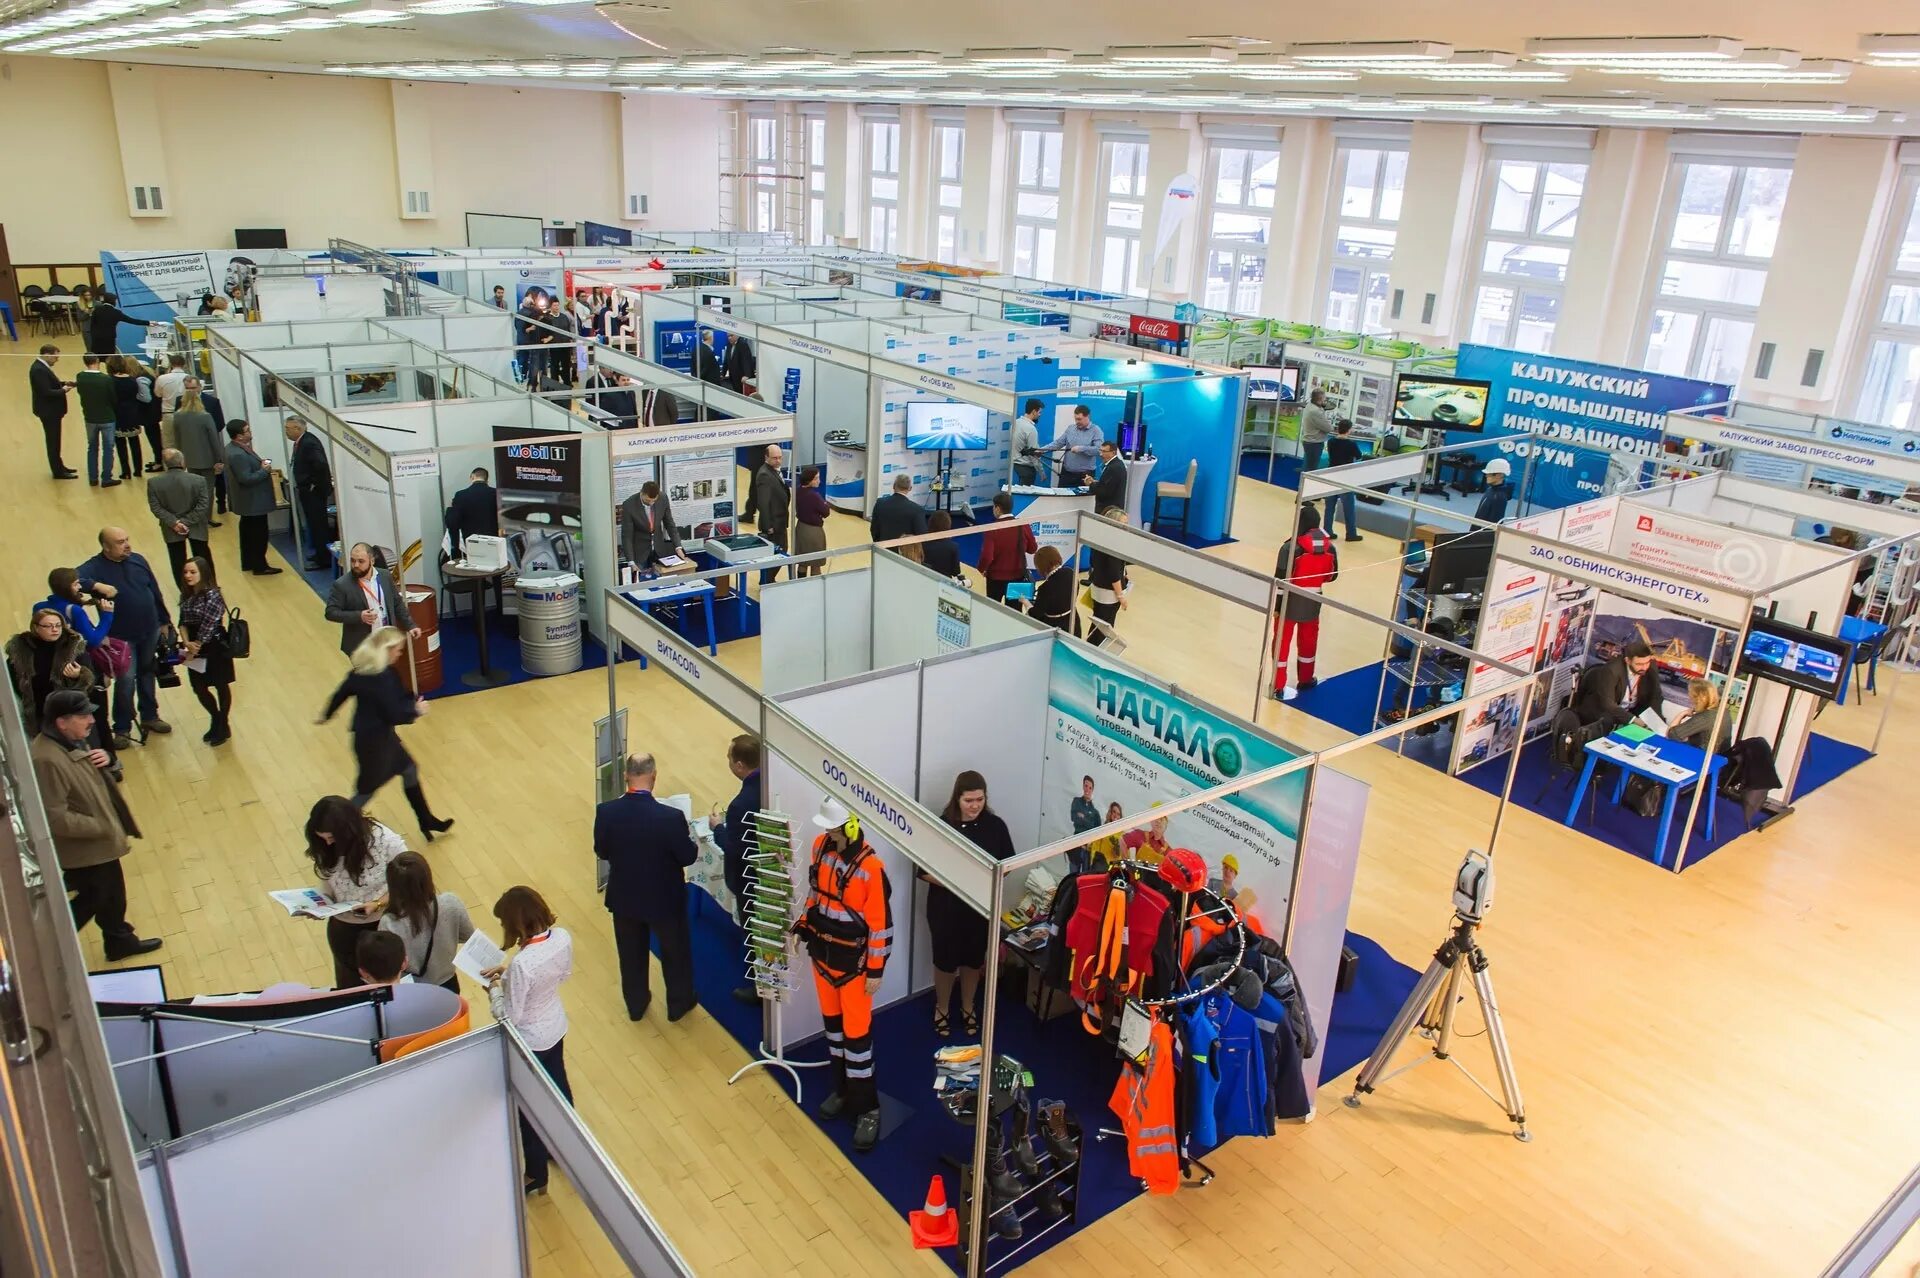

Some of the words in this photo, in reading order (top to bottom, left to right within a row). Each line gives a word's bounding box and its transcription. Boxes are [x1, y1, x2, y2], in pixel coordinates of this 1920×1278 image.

[114, 262, 145, 272] ПЕРВЫЙ
[146, 256, 201, 268] БЕЗЛИМИТНЫЙ
[116, 269, 154, 279] ИНТЕРНЕТ
[155, 268, 171, 276] ДЛЯ
[172, 264, 205, 274] БИЗНЕСА
[1511, 361, 1650, 399] КАЛУЖСКИЙ
[1507, 387, 1667, 432] ПРОМЫШЛЕНН
[507, 445, 549, 460] Mobil
[628, 438, 668, 447] КАЛУЖСКИЙ
[668, 431, 717, 444] СТУДЕНЧЕСКИЙ
[717, 426, 778, 438] БИЗНЕС-ИНКУБАТОР
[1498, 439, 1575, 468] ФОРУМ
[1502, 414, 1707, 467] ИННОВАЦИОНН
[1719, 430, 1774, 448] КАЛУЖСКИЙ
[1775, 441, 1808, 455] ЗАВОД
[1809, 447, 1875, 467] ПРЕСС-ФОРМ
[1529, 545, 1555, 561] ЗАО
[1557, 554, 1710, 605] «ОБНИНСКЭНЕРГОТЕХ»
[656, 639, 701, 680] ВИТАСОЛЬ
[1096, 676, 1243, 778] НАЧАЛО
[1134, 733, 1174, 763] продажа
[1176, 756, 1240, 798] спецодежы
[822, 757, 848, 788] ООО
[850, 782, 915, 837] «НАЧАЛО»
[1197, 801, 1275, 848] ecovochka@mail.ru
